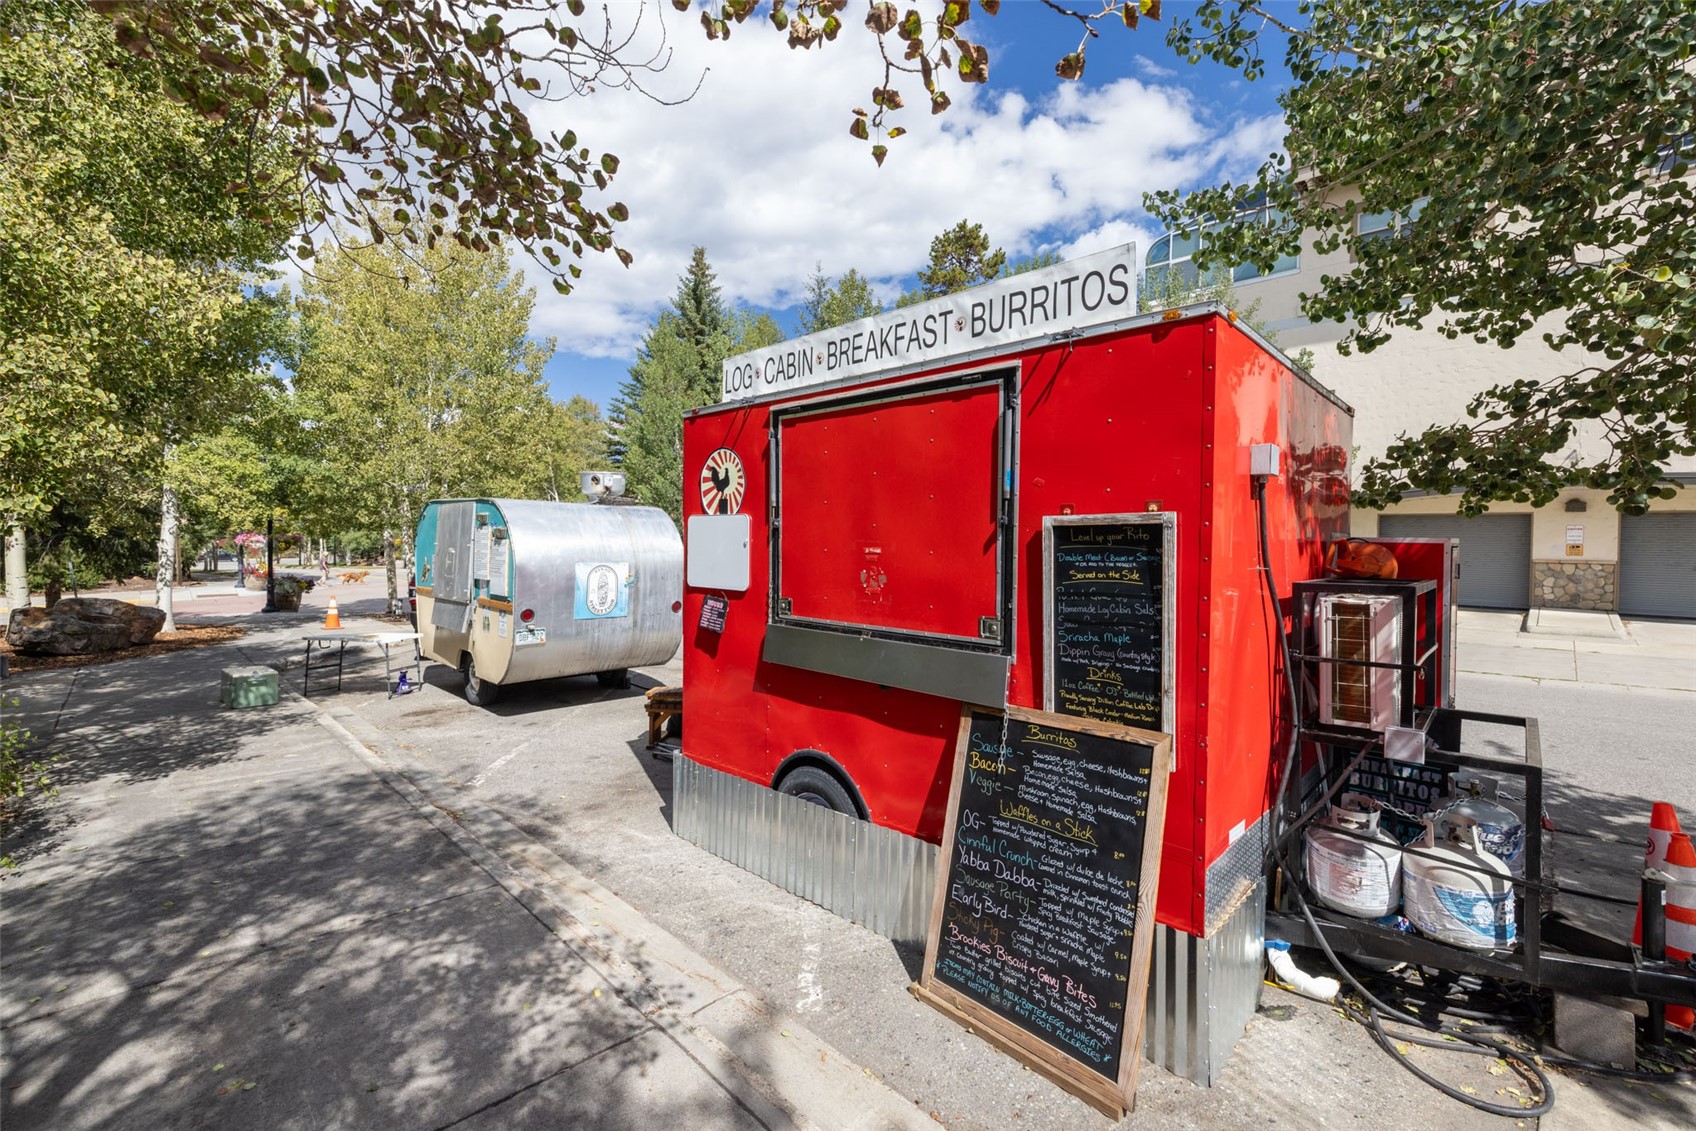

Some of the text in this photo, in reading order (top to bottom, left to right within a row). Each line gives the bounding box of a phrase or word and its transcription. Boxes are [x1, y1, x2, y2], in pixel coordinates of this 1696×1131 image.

[724, 263, 1129, 394] LOG CABIN BREAKFAST BURRITOS
[1070, 527, 1093, 541] Level
[1096, 534, 1104, 544] up
[1106, 533, 1124, 546] your
[1057, 552, 1084, 562] Double
[1069, 569, 1096, 580] Served
[1108, 570, 1120, 578] the
[1122, 570, 1140, 580] Side
[1058, 602, 1131, 618] Homemade Log Cabin
[1058, 630, 1100, 642] Sriracha
[1058, 643, 1090, 657] Dippin
[1087, 666, 1122, 682] Drinks
[1062, 679, 1076, 688] 12oz
[1078, 681, 1100, 693] Coffee
[1088, 706, 1104, 714] Black
[1115, 700, 1133, 709] Coffee
[1026, 724, 1076, 748] Burritos
[1034, 760, 1086, 780] Homemade Salsa
[1058, 785, 1077, 798] Salsa
[1000, 799, 1038, 823] Waffles
[1056, 822, 1061, 830] a
[1064, 818, 1096, 843] Stick
[1046, 800, 1097, 824] Homemade Salsa
[988, 816, 1010, 828] Topped
[992, 827, 1020, 840] Homemade
[958, 844, 990, 872] Yabba
[1043, 878, 1070, 894] Drizzled
[1072, 889, 1080, 898] w/
[1041, 854, 1064, 868] Glazed
[1067, 863, 1076, 873] w/
[1076, 864, 1094, 878] dulce
[1095, 870, 1104, 881] de
[1108, 872, 1124, 889] leche
[956, 864, 995, 896] Sausage
[1038, 897, 1062, 912] Topped
[1066, 908, 1074, 917] w/
[1092, 879, 1109, 891] toast
[1087, 903, 1096, 912] w/
[947, 901, 980, 935] Sticky
[1011, 930, 1034, 945] Coated
[1037, 941, 1046, 952] w/
[952, 884, 982, 918] Early
[1022, 913, 1047, 927] Chicken
[1095, 942, 1105, 952] w/
[1087, 926, 1116, 945] Sausage
[948, 922, 992, 954] Brookies
[994, 945, 1028, 973] Biscuit
[1062, 974, 1097, 1009] Bites
[1034, 949, 1059, 968] Bacon
[1005, 965, 1026, 982] biscuits
[1020, 985, 1029, 994] w/
[941, 964, 966, 983] PLEASE
[968, 981, 989, 997] NOTIFY
[991, 992, 1001, 1002] US
[1015, 1005, 1029, 1018] ANY
[1031, 1014, 1051, 1032] FOOD
[1056, 1030, 1101, 1062] ALLERGIES
[1072, 1028, 1104, 1050] WHEAT
